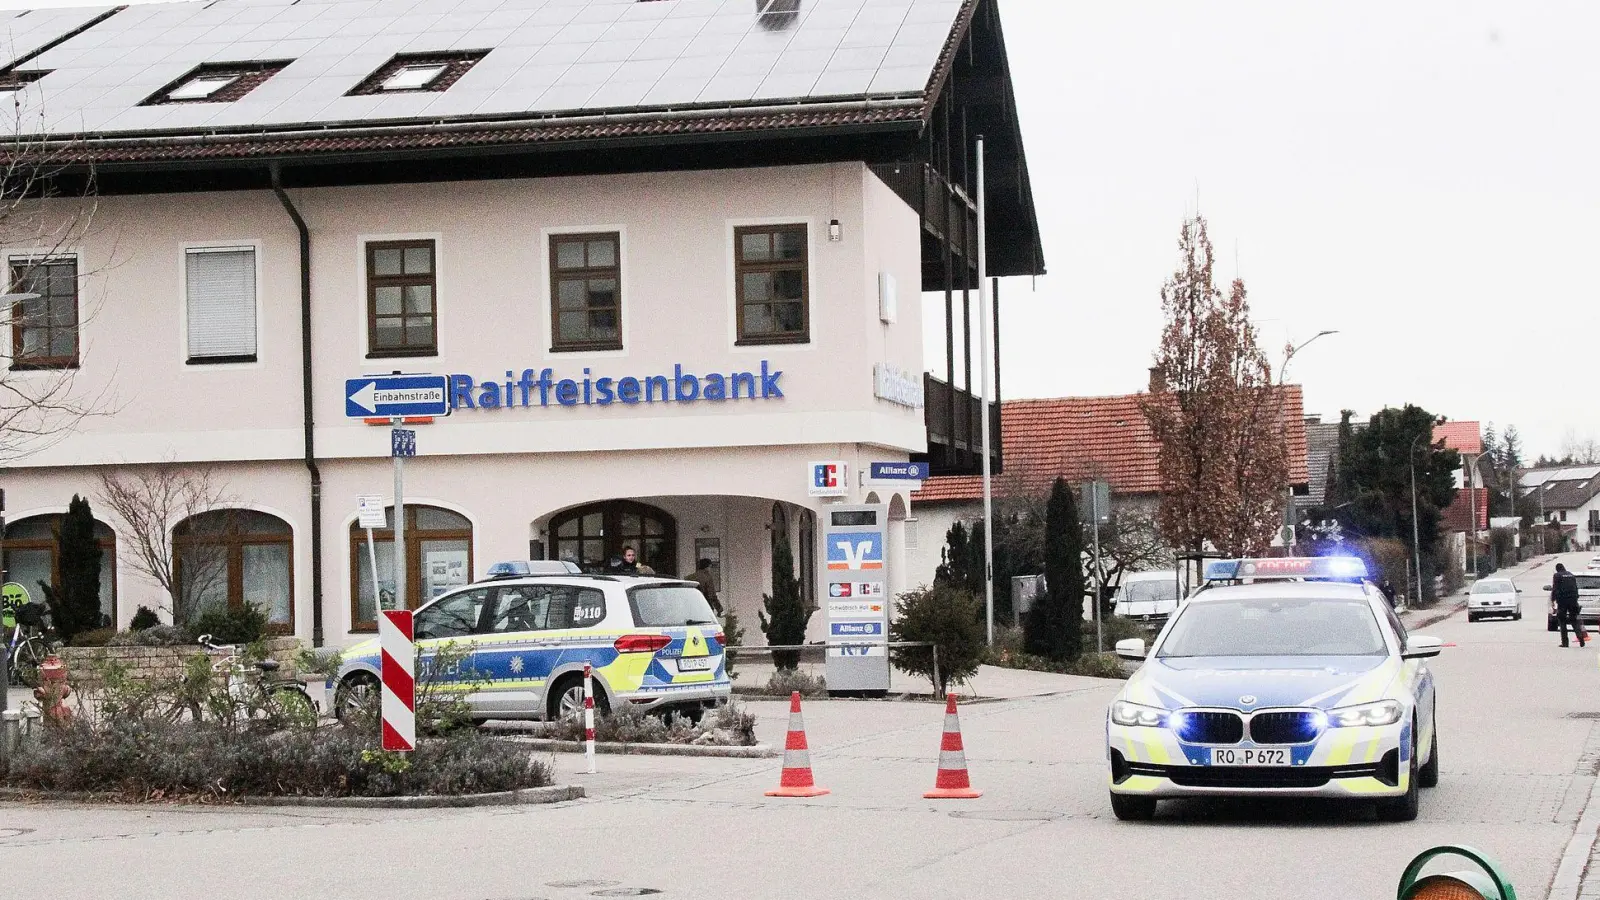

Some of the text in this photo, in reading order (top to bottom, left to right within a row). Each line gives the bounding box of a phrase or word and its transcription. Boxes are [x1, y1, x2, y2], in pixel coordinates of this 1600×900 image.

[450, 360, 784, 408] Raiffeisenbank
[373, 391, 441, 402] Einbahnstraße
[879, 466, 908, 475] Allianz
[584, 606, 601, 619] 110
[661, 648, 682, 656] POLIZEI
[1216, 749, 1284, 764] RO P 672
